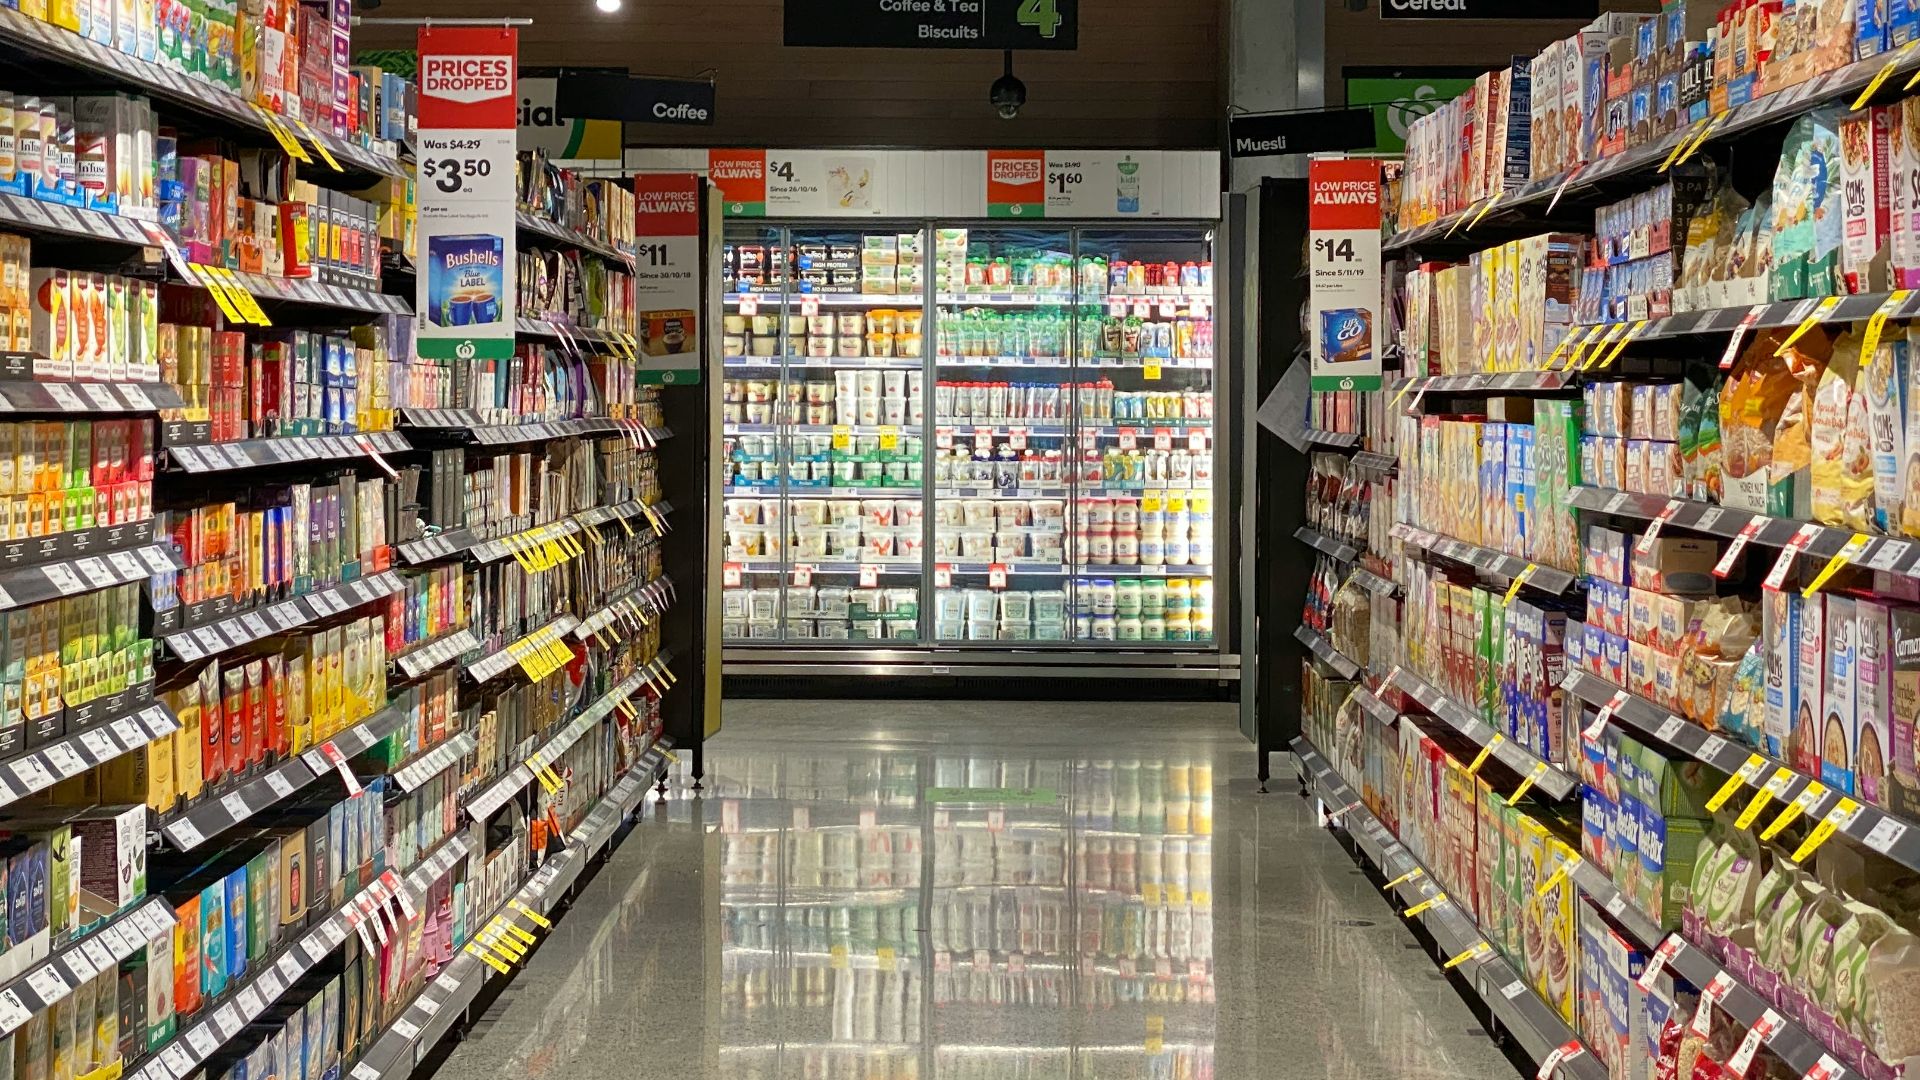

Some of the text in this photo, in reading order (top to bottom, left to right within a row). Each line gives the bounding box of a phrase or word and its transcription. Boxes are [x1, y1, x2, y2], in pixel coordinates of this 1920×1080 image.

[1016, 0, 1062, 38] 4
[918, 24, 978, 39] Biscuits
[427, 60, 508, 77] PRICES
[427, 78, 508, 91] DROPPED
[652, 102, 708, 120] Coffee
[423, 139, 481, 150] Was $4.29
[1236, 136, 1286, 152] Muesli
[713, 160, 762, 168] LOW PRICE
[994, 162, 1038, 171] PRICES
[713, 169, 762, 179] ALWAYS
[769, 161, 794, 182] $4
[1314, 181, 1376, 191] LOW PRICE
[638, 191, 695, 201] LOW PRICE
[1314, 191, 1377, 205] ALWAYS
[638, 201, 696, 213] ALWAYS
[639, 244, 667, 266] $11
[1315, 238, 1355, 262] $14
[446, 249, 499, 269] Bushells
[464, 270, 481, 278] Blue
[460, 278, 486, 287] LABEL
